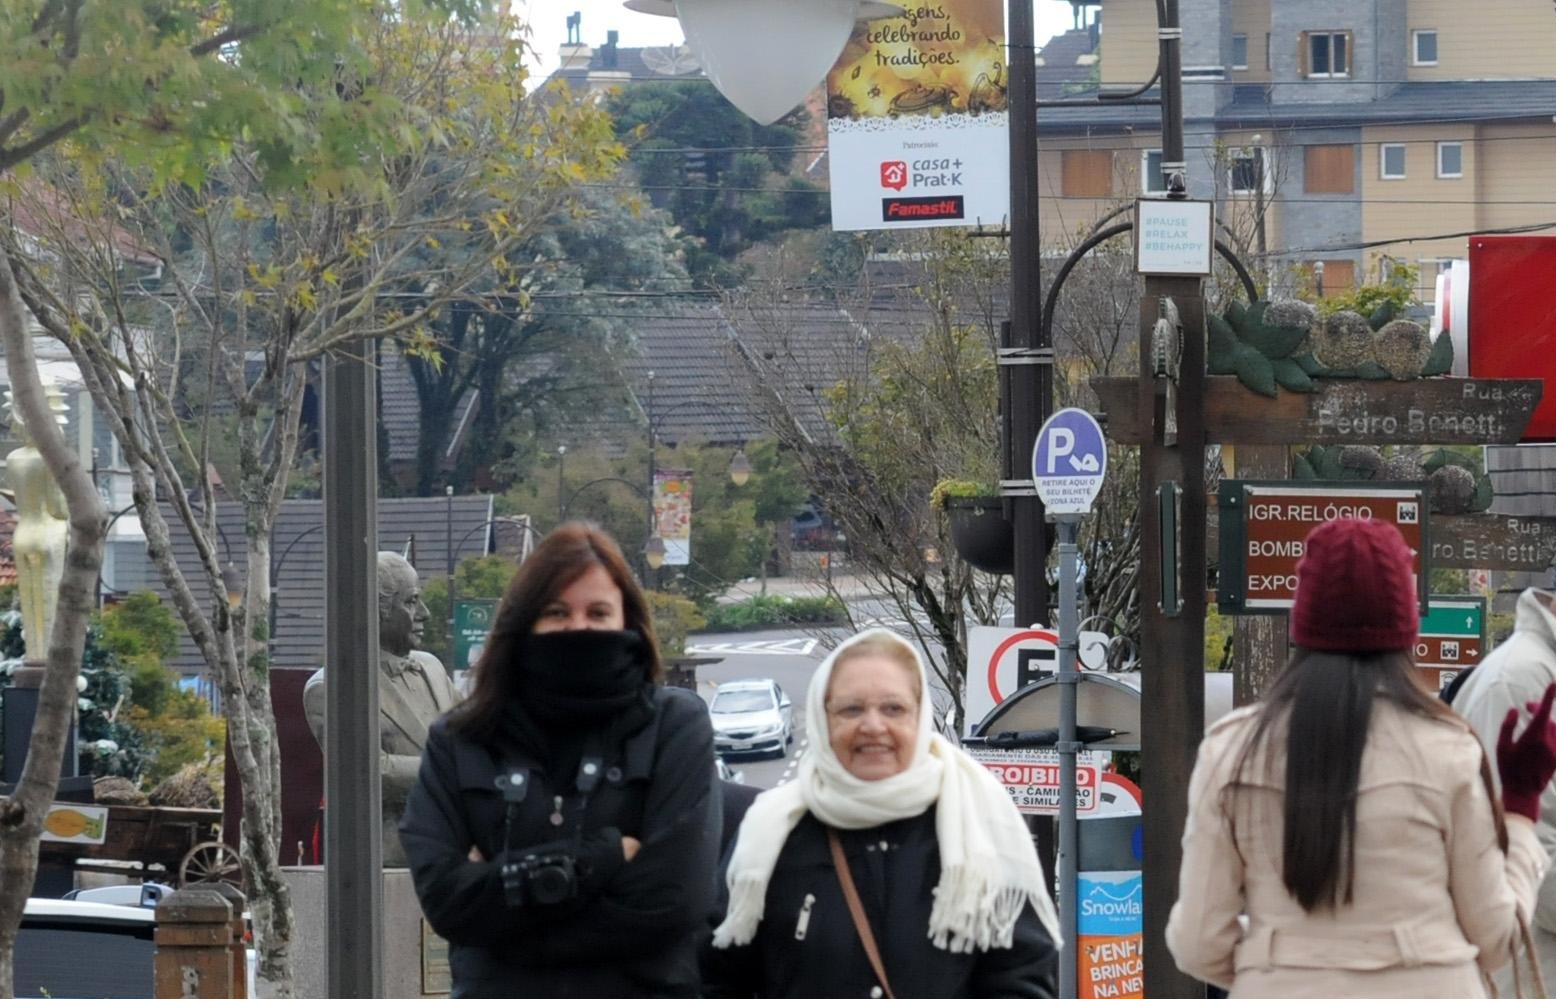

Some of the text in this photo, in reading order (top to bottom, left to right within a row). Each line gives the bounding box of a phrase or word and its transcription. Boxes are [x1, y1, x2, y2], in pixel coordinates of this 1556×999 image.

[897, 4, 950, 27] igens,
[867, 25, 960, 43] celebrando
[876, 48, 960, 69] tradições.
[1145, 217, 1188, 226] #PAUSE
[1145, 230, 1188, 238] #RELAX
[1145, 242, 1203, 251] #BEHAPPY
[1463, 384, 1502, 400] Rua
[1317, 409, 1398, 434] Pedro
[1047, 427, 1075, 473] P
[1249, 503, 1372, 521] IGR.RELÓGIO
[1507, 518, 1541, 534] Rua
[1249, 541, 1307, 556] BOMB
[988, 766, 1090, 786] ROIBIO
[1093, 983, 1119, 999] NA
